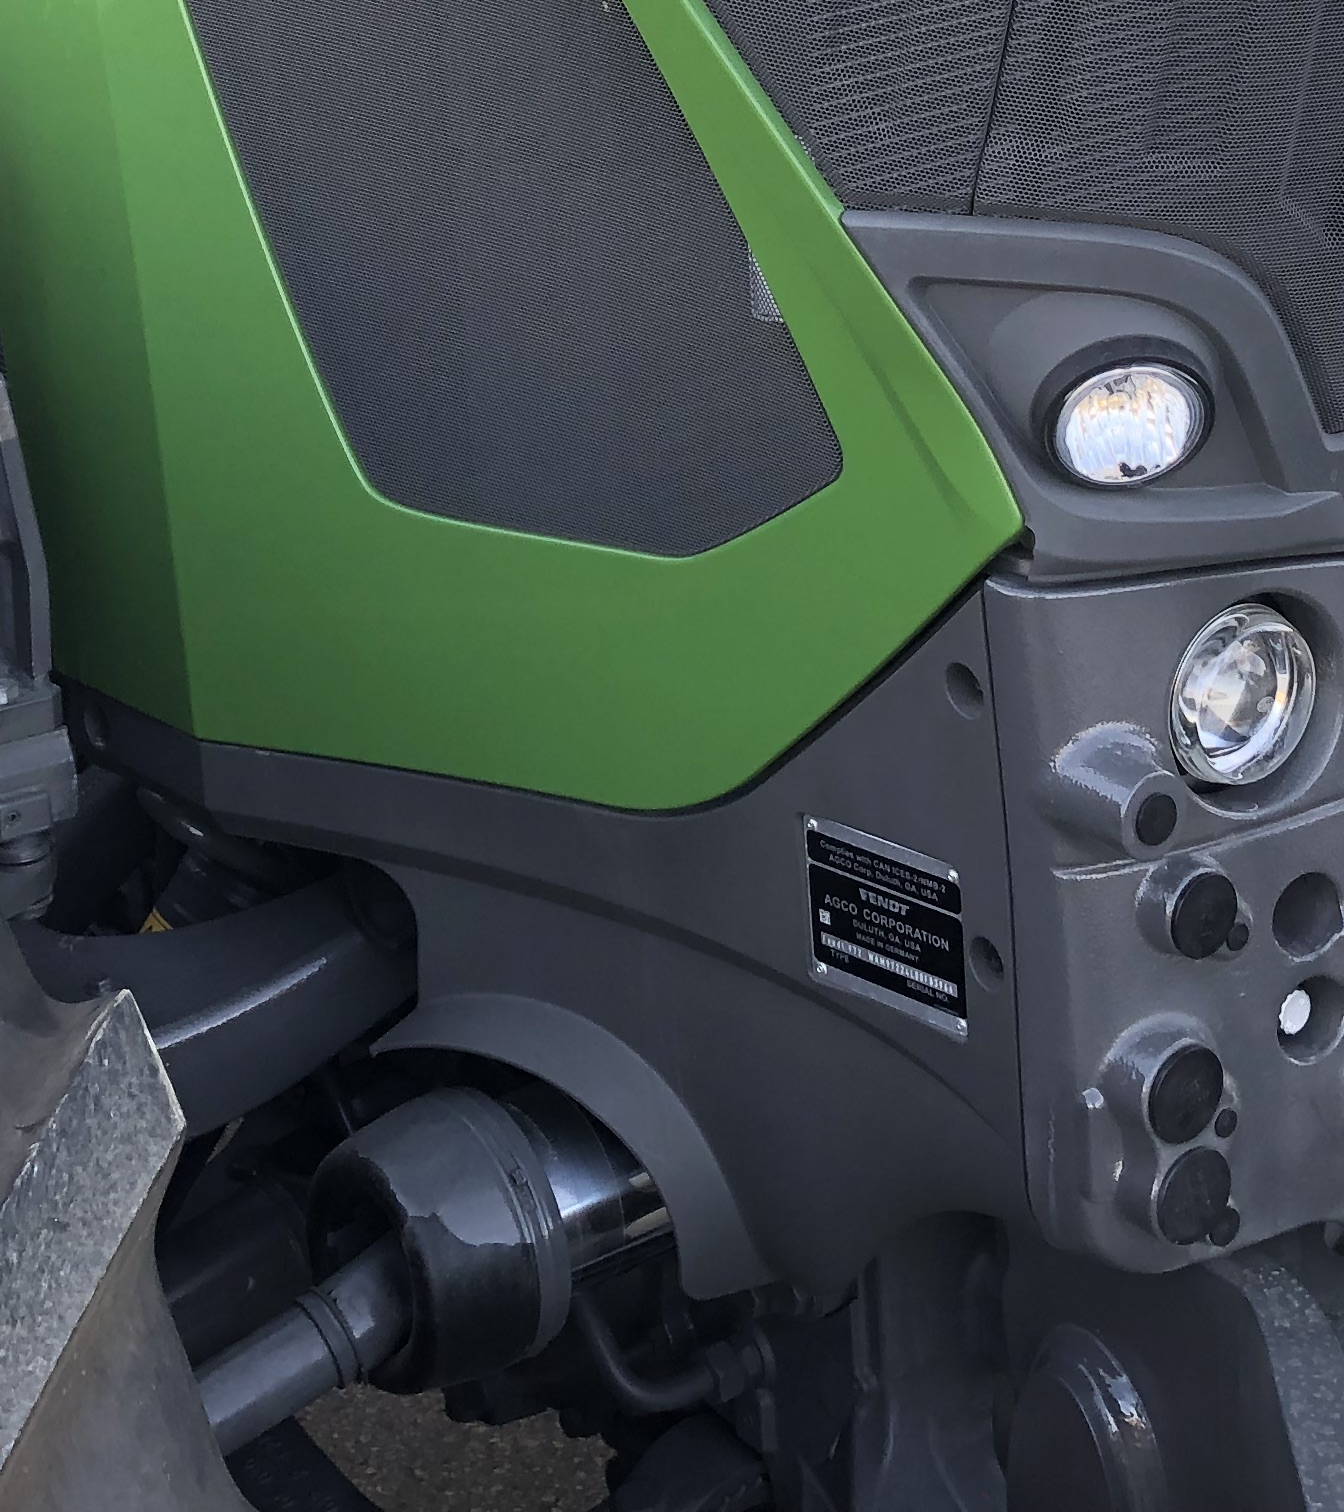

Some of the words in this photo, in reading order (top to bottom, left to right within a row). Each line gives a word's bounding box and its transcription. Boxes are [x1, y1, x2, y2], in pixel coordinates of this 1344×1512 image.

[829, 853, 852, 869] AGCO
[920, 888, 939, 902] USA
[856, 854, 872, 868] with
[873, 859, 890, 873] CAN
[858, 887, 910, 916] FENDT
[824, 893, 858, 916] AGCO
[863, 908, 950, 952] CORPORATION
[904, 938, 922, 953] USA
